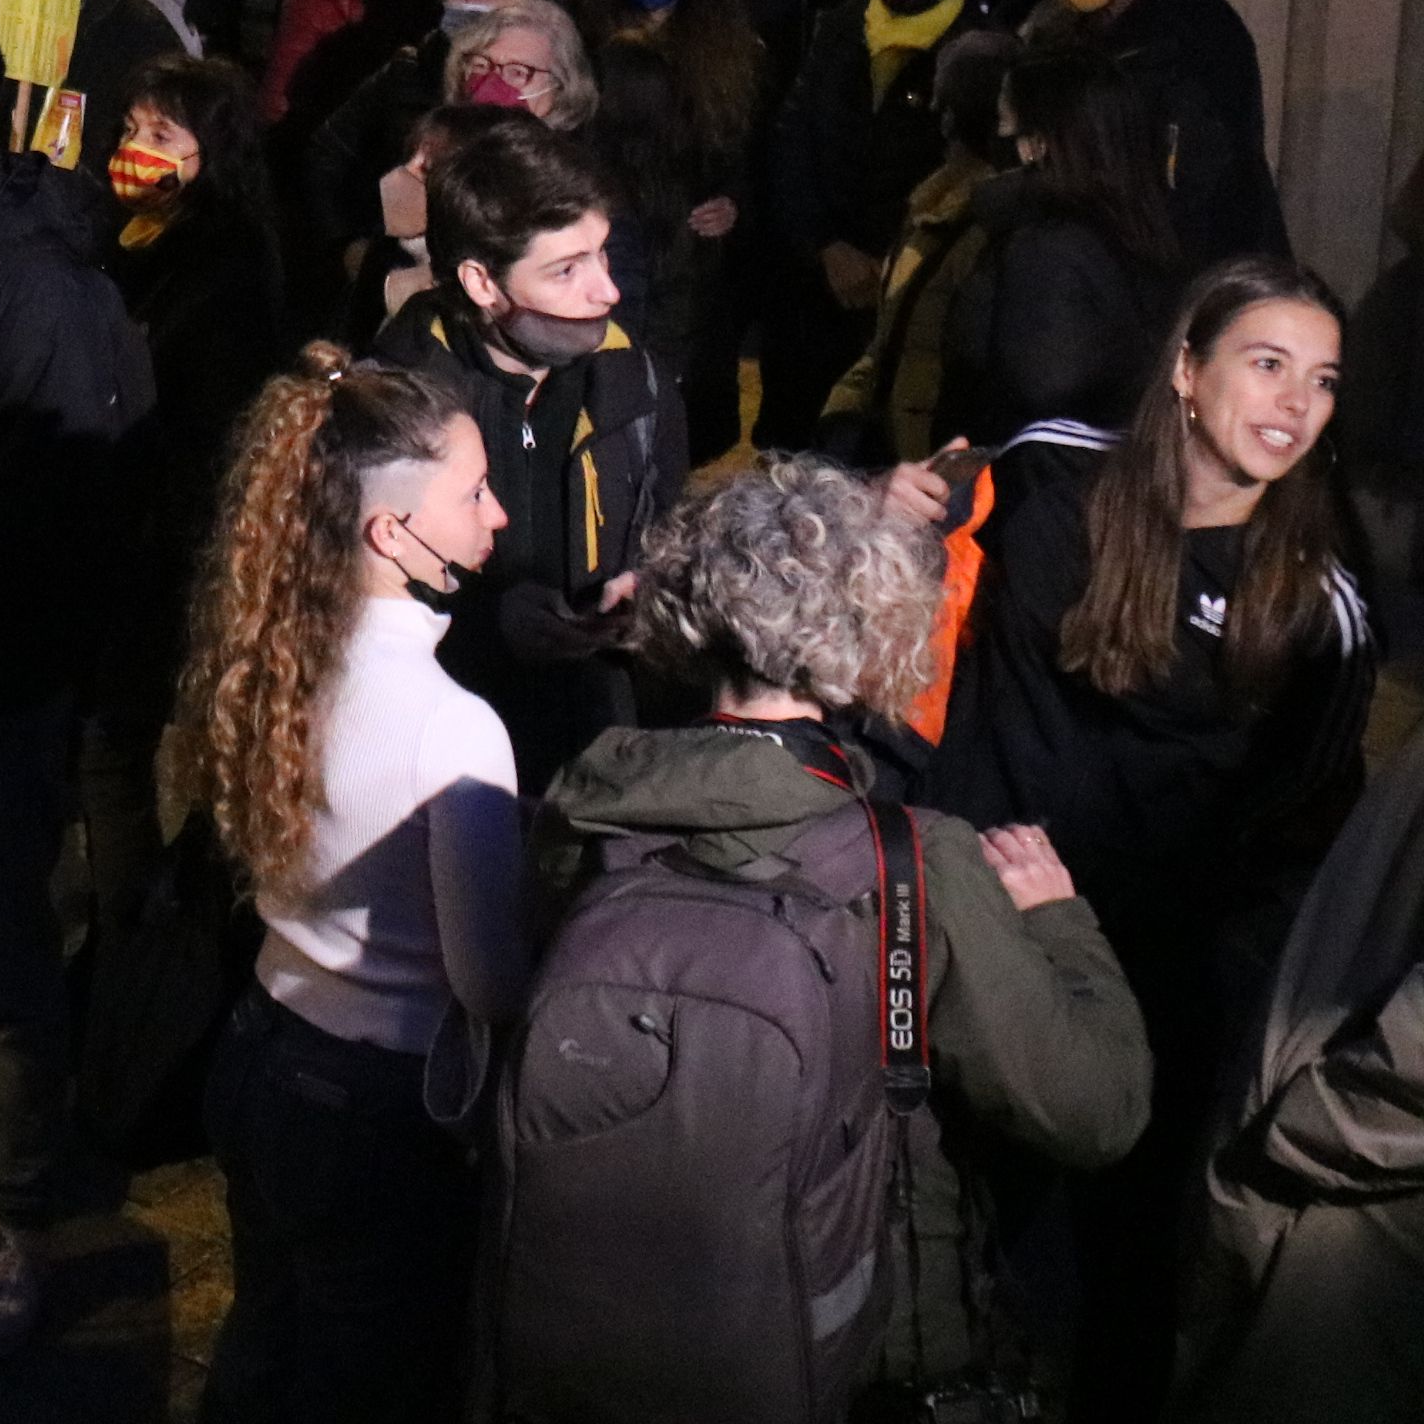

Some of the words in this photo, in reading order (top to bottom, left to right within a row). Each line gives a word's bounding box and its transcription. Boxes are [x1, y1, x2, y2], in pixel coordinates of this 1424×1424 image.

[895, 898, 912, 943] Mark
[890, 948, 913, 982] 5D
[890, 987, 914, 1051] EOS
